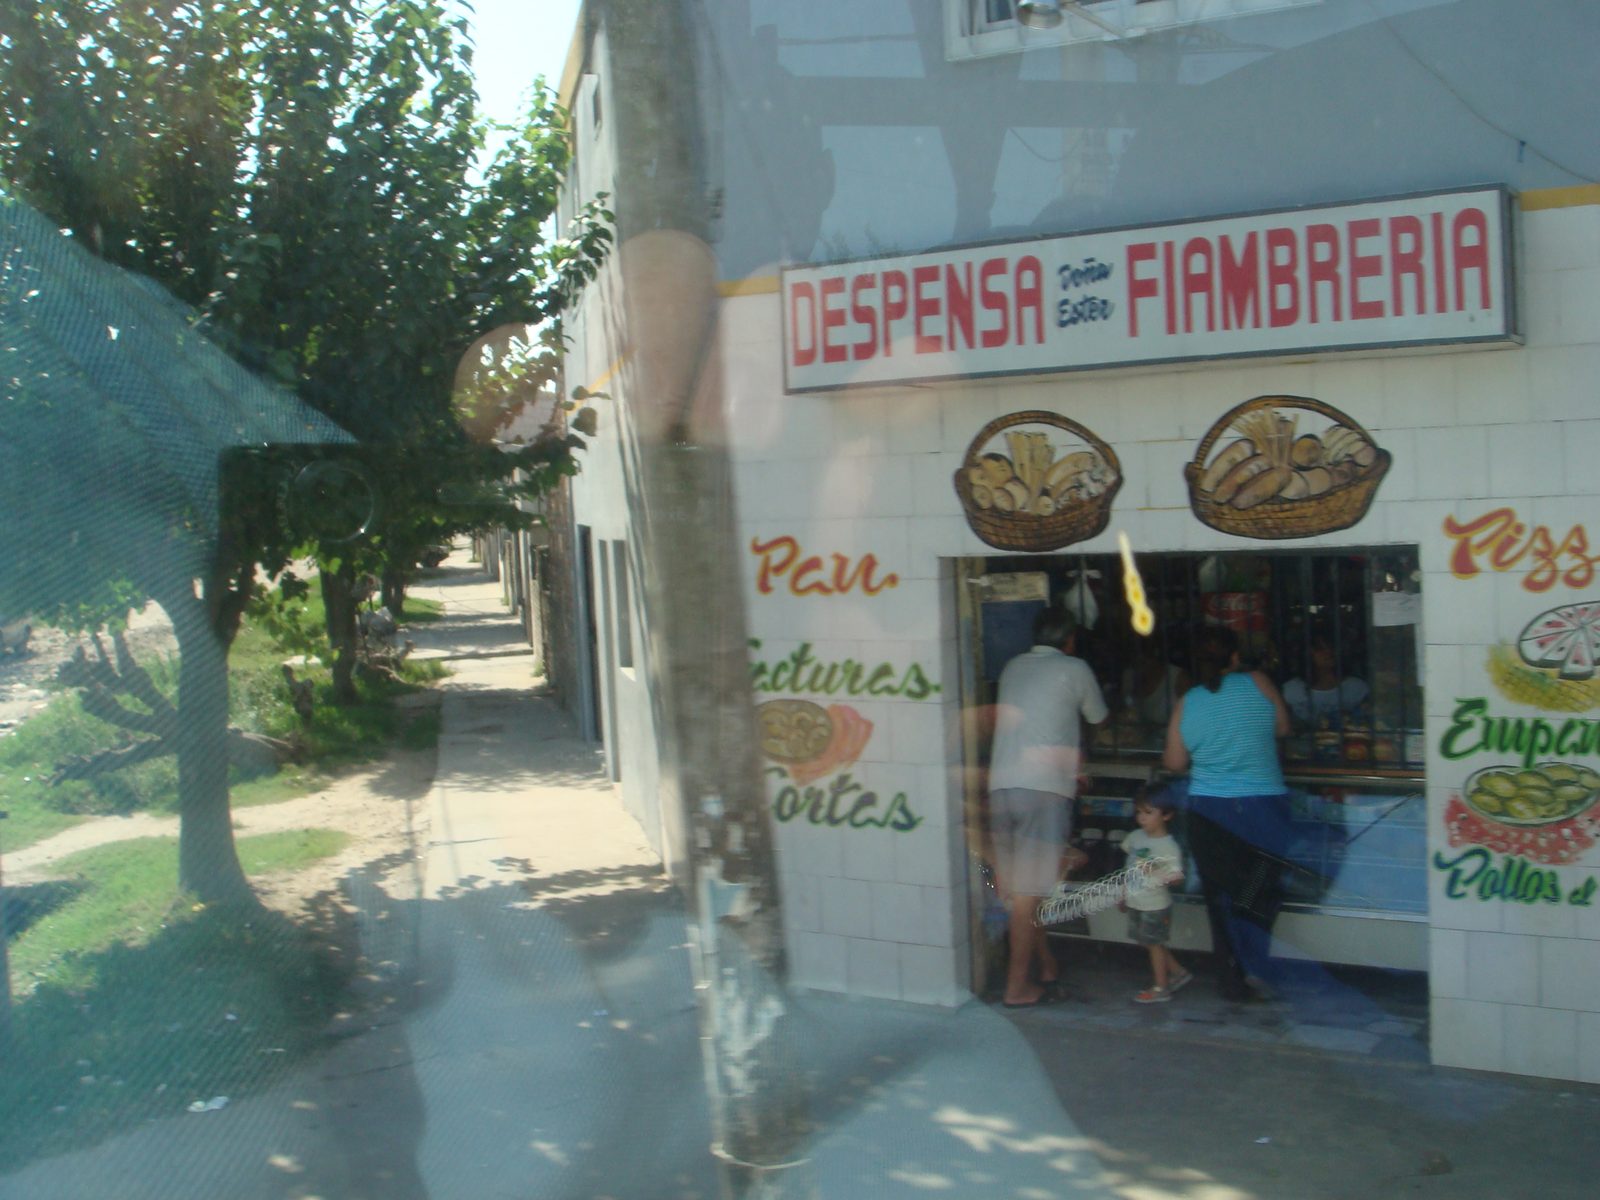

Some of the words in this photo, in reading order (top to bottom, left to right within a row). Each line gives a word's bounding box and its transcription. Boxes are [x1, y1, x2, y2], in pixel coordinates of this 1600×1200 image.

[791, 255, 1045, 367] DESPENSA
[1126, 207, 1492, 338] FIAMBRERIA
[751, 535, 900, 596] Pan
[747, 637, 943, 700] acturas
[1434, 847, 1562, 905] Pollos
